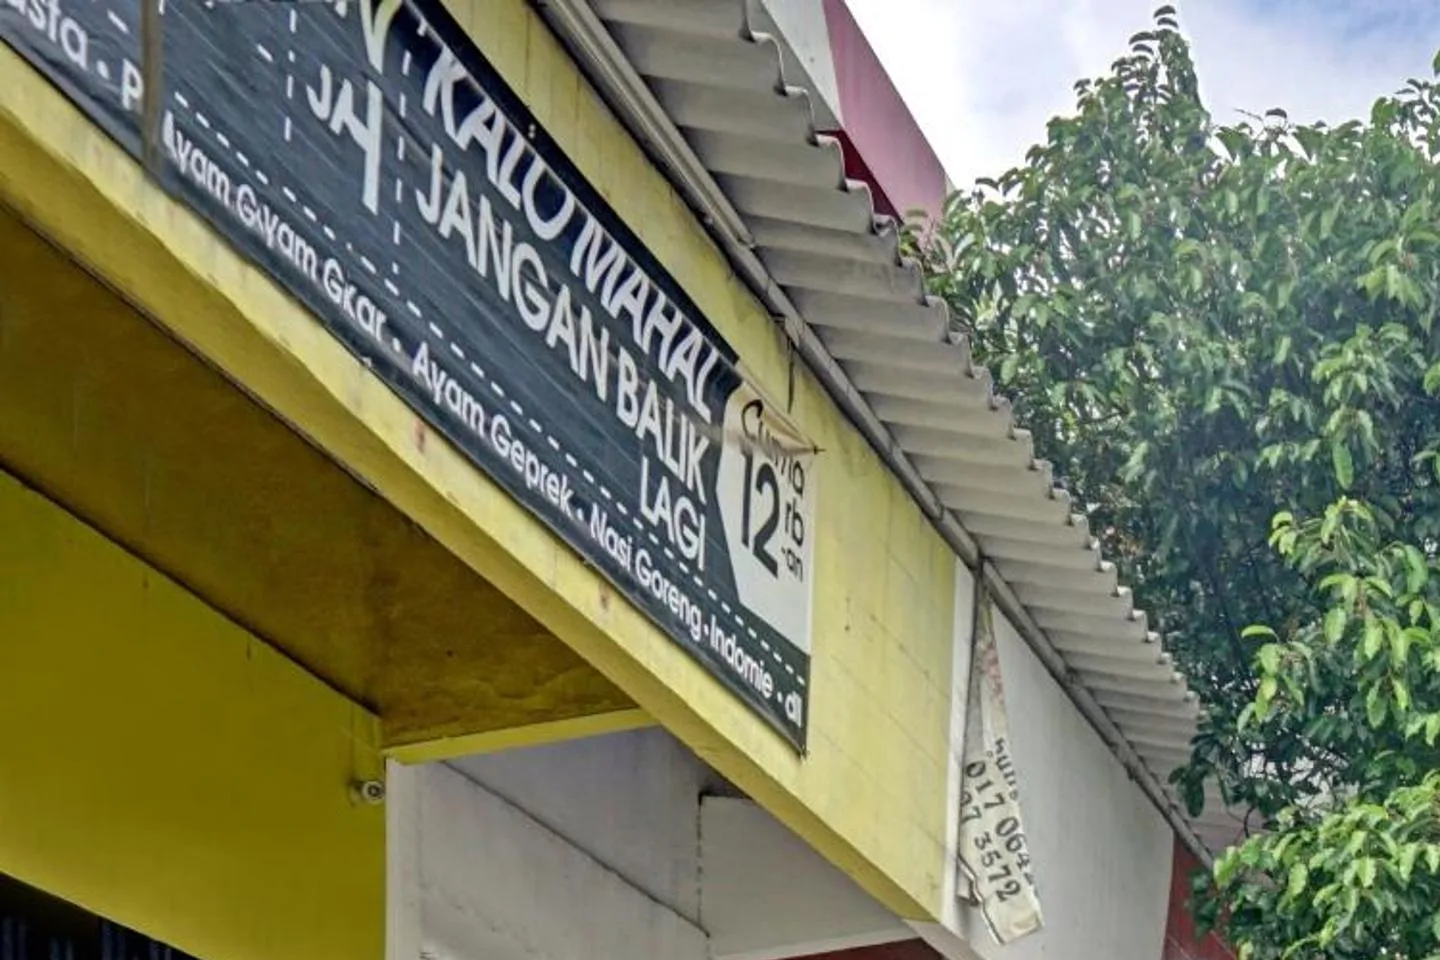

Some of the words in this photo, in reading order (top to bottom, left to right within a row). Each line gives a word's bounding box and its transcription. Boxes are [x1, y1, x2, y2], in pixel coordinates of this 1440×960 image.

[415, 143, 610, 402] JANGAN
[569, 212, 719, 425] MAHAL
[616, 345, 710, 506] BALIK
[412, 341, 486, 440] Ayam
[490, 413, 575, 521] Geprek
[589, 502, 633, 572] Nasi
[634, 548, 703, 642] Goreng
[709, 614, 775, 699] Indomie
[639, 454, 705, 571] LAGI
[739, 445, 779, 581] 12
[974, 830, 1022, 903] 3572
